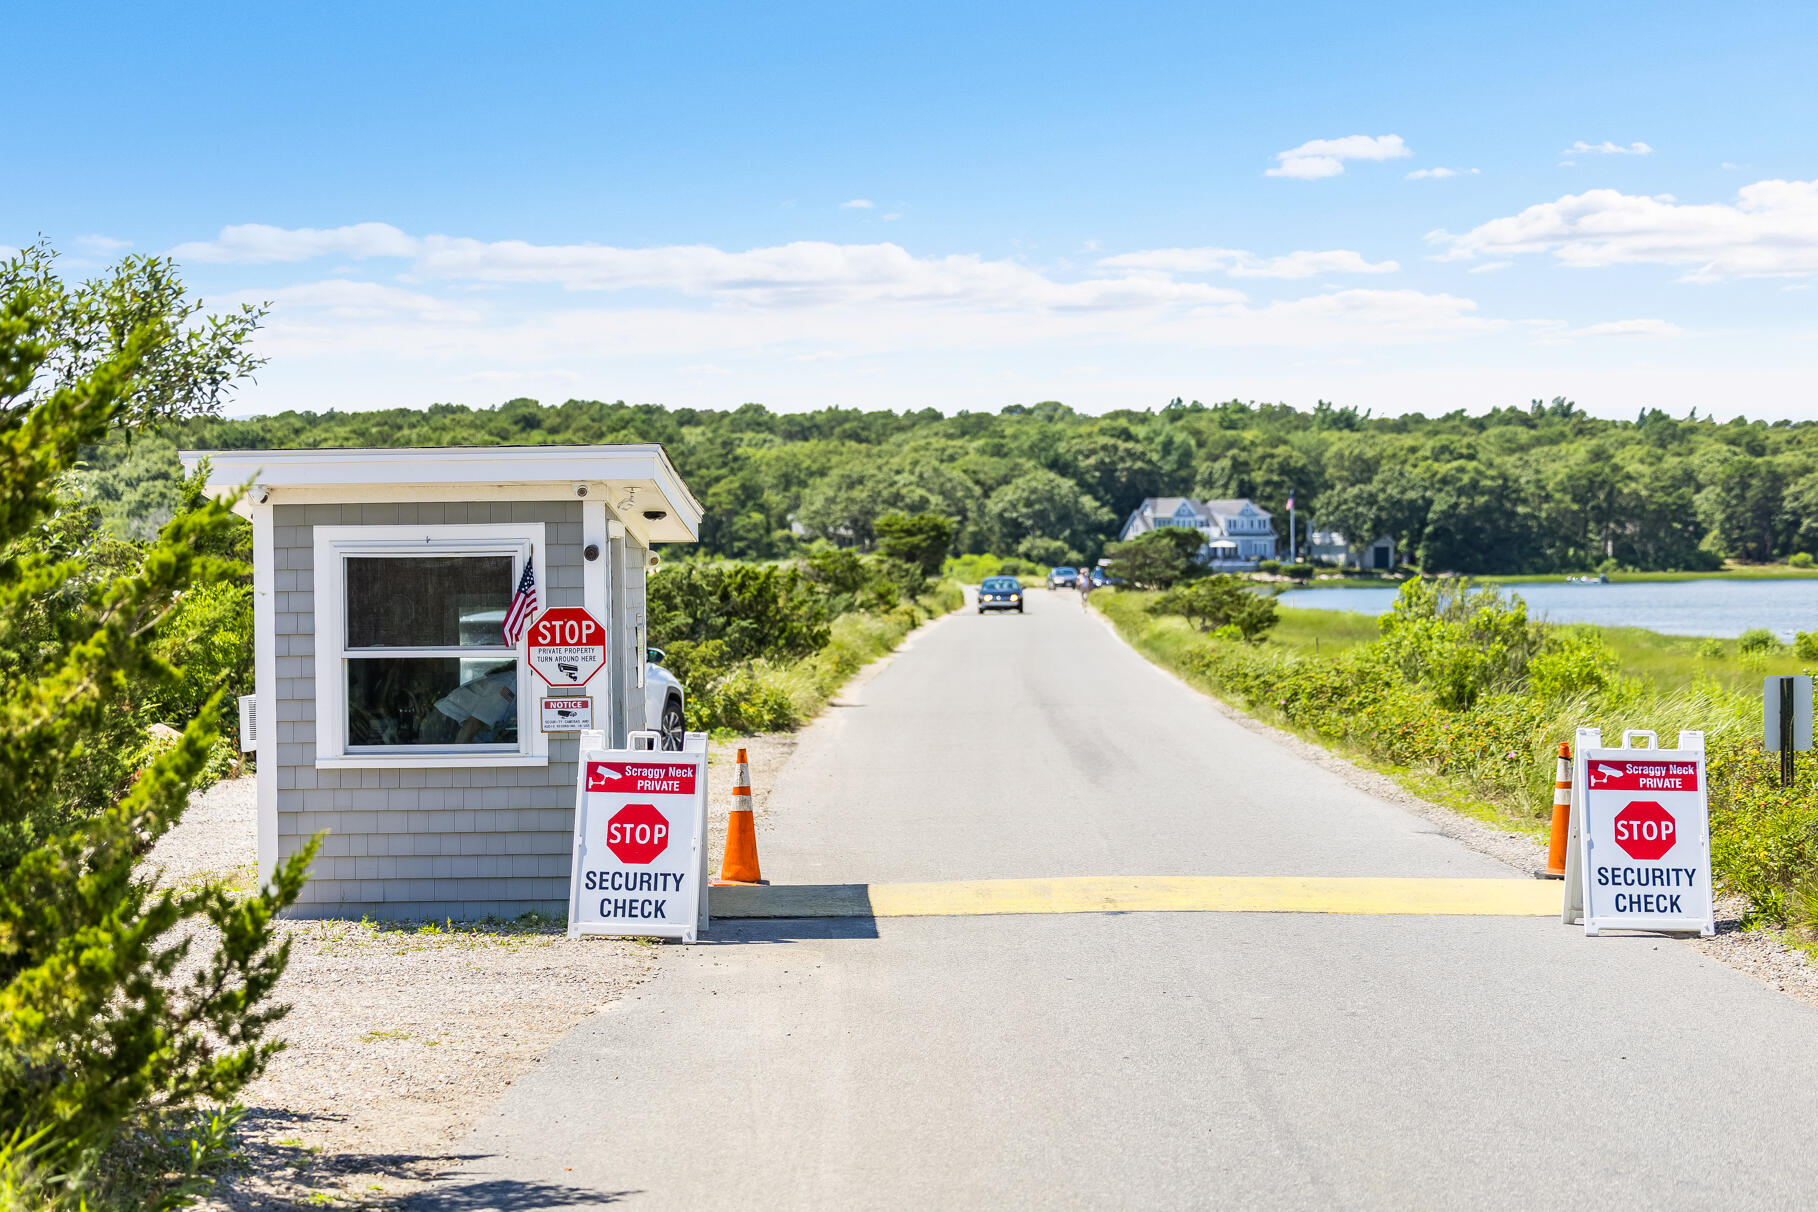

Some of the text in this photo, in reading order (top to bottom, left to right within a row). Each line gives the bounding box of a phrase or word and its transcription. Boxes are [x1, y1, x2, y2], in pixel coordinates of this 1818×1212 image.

[538, 620, 595, 644] STOP
[550, 701, 582, 709] NOTICE
[625, 765, 693, 779] Scraggy Neck
[1626, 763, 1695, 777] Scraggy Neck
[637, 780, 680, 792] PRIVATE
[1639, 777, 1682, 789] PRIVATE
[609, 823, 667, 845] STOP
[1616, 820, 1674, 841] STOP
[585, 870, 685, 892] SECURITY
[1597, 867, 1697, 887] SECURITY
[600, 898, 667, 919] CHECK
[1615, 893, 1682, 913] CHECK
